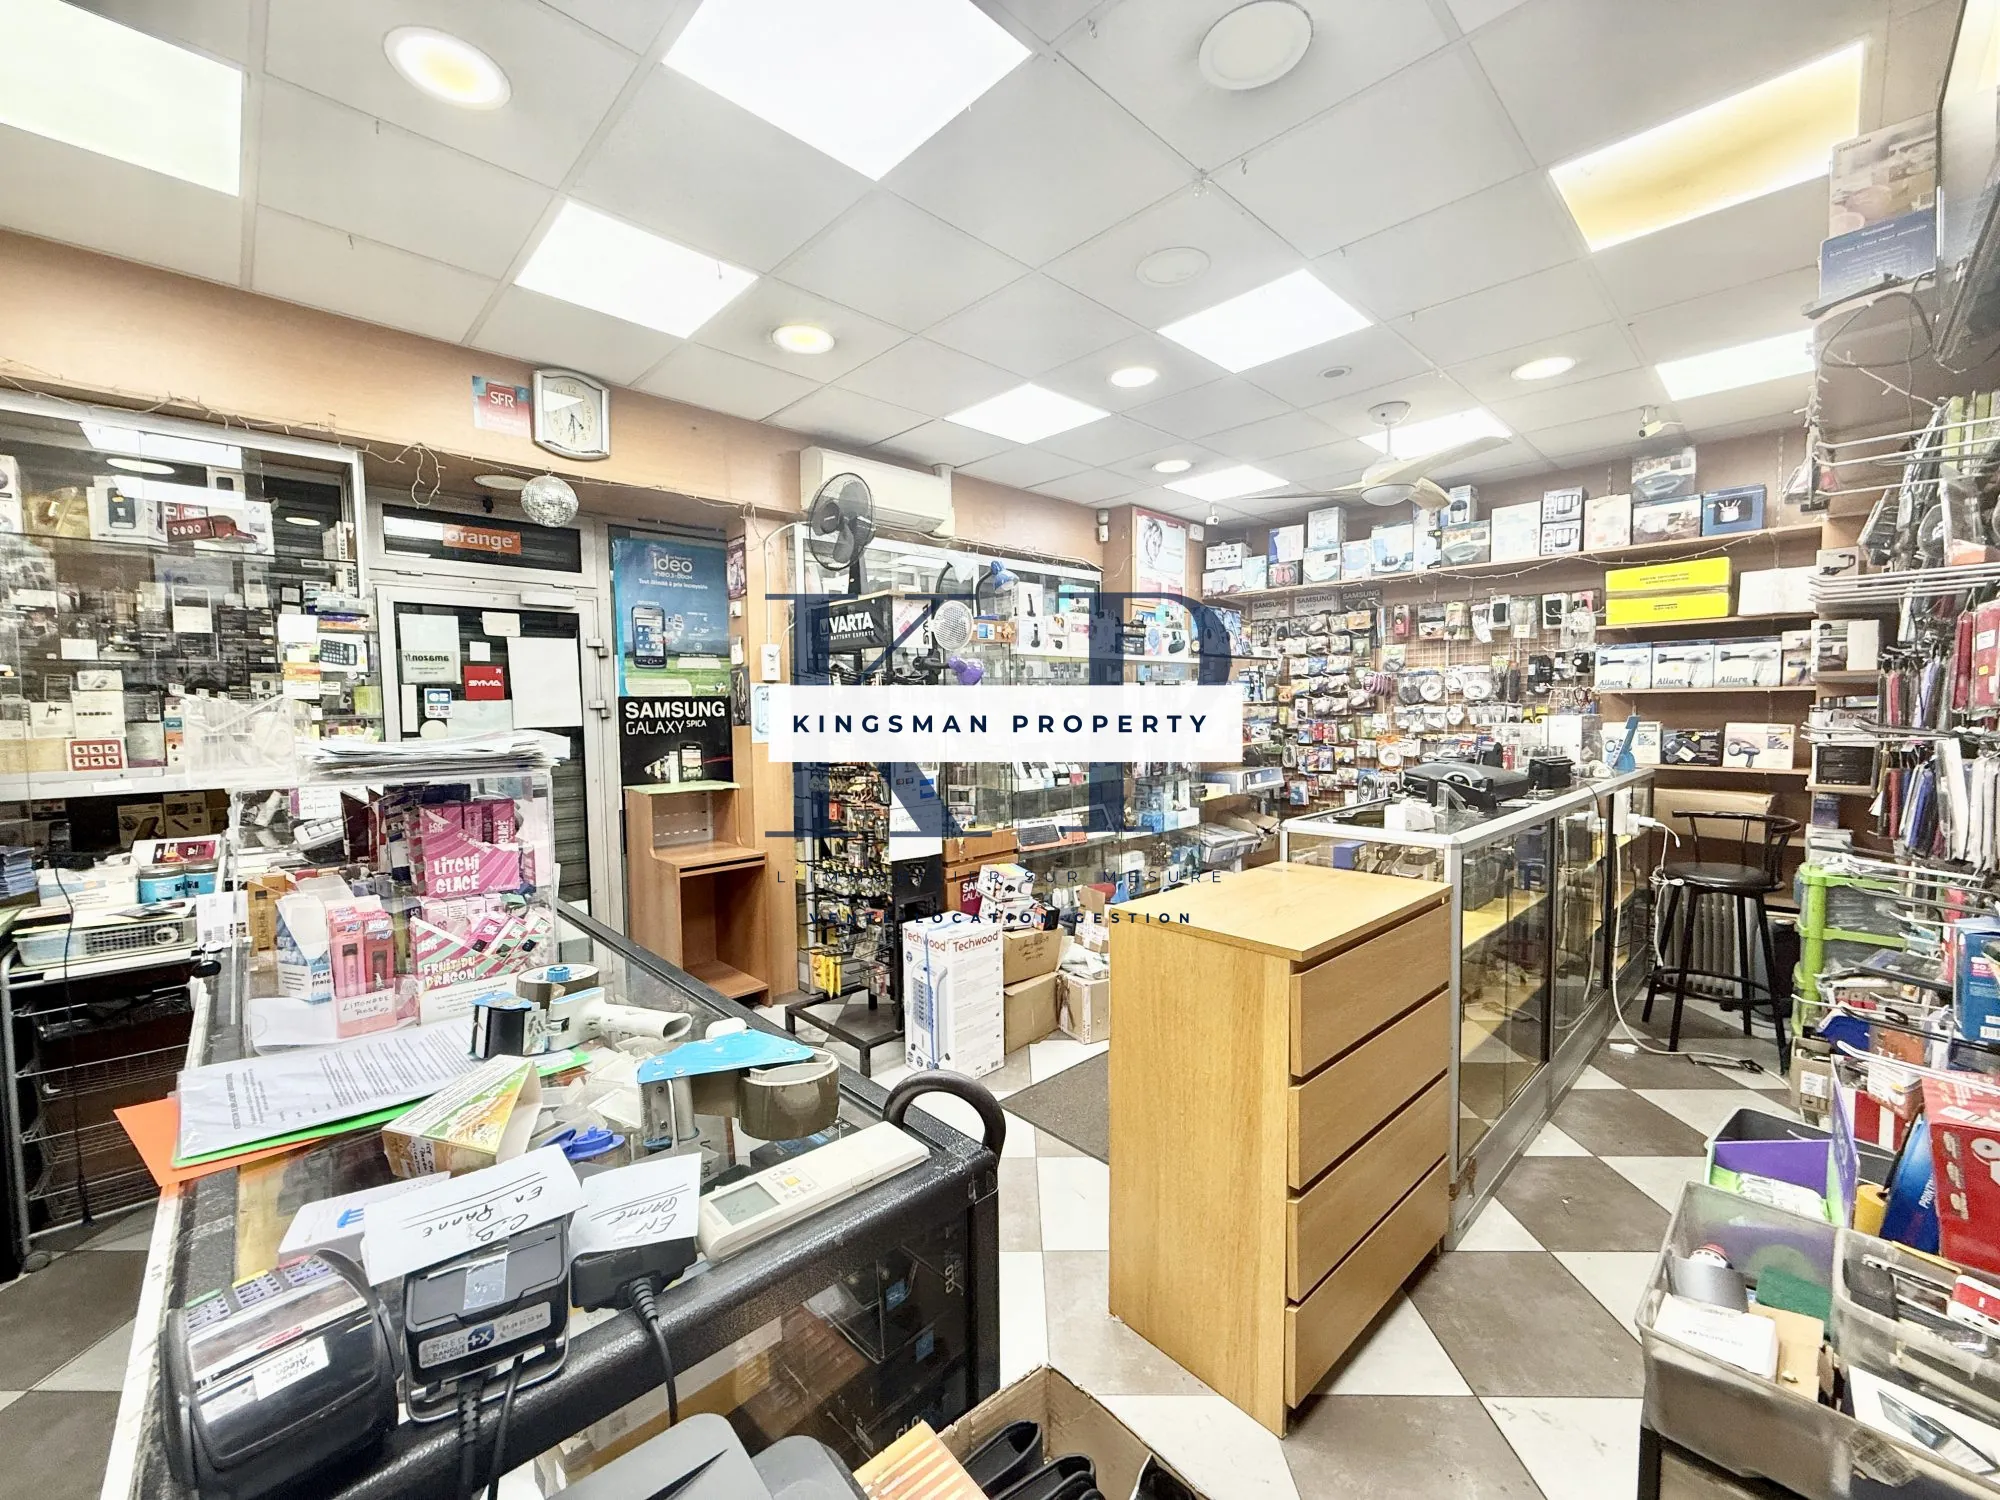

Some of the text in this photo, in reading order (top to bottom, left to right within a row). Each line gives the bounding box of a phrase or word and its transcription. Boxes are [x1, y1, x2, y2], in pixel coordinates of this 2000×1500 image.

[489, 391, 515, 409] SFR
[446, 529, 513, 550] orange
[653, 553, 693, 573] ideo
[1296, 596, 1332, 604] SAMSUNG
[1342, 590, 1380, 600] SAMSUNG
[1254, 600, 1288, 609] SAMSUNG
[829, 611, 874, 634] VARTA
[1599, 679, 1623, 687] Allure
[1656, 677, 1684, 686] Allure
[1719, 675, 1748, 685] Allure
[625, 700, 726, 719] SAMSUNG
[626, 719, 707, 736] GALAXY SPICA
[434, 854, 480, 876] LITCHI
[436, 870, 480, 894] GLACÉ
[953, 932, 999, 953] Techwood
[425, 967, 476, 990] DRAGON
